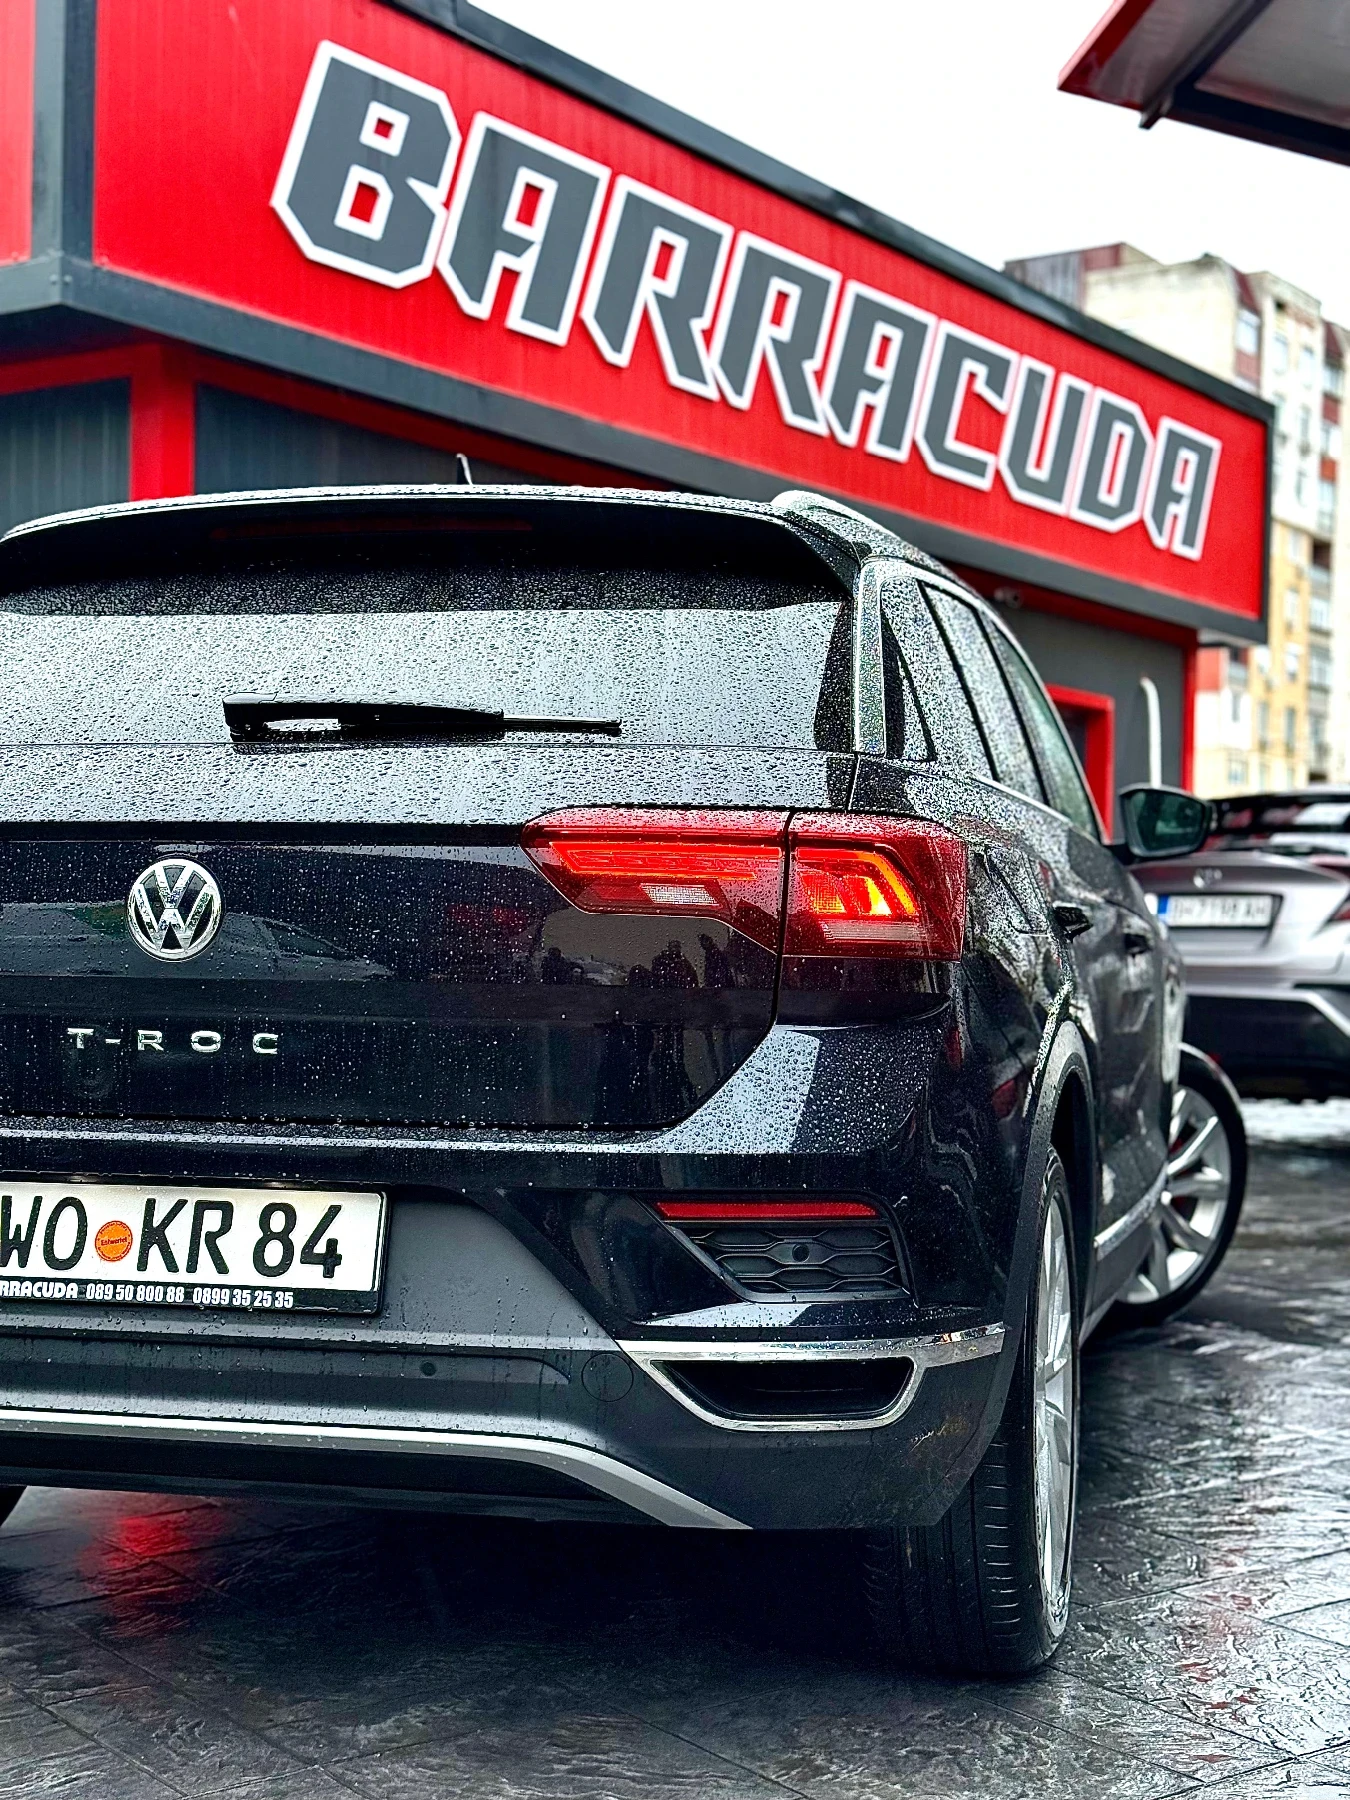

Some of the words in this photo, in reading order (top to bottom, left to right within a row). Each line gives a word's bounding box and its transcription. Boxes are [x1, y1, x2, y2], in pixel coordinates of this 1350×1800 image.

[271, 40, 1221, 561] BARRACUDA
[67, 1027, 279, 1055] T-ROC
[0, 1195, 88, 1271] WO
[136, 1197, 234, 1275] KR
[252, 1202, 343, 1279] 84
[85, 1283, 114, 1300] 089
[115, 1284, 135, 1301] 50
[136, 1284, 164, 1302] 800
[166, 1285, 185, 1303] 88
[192, 1287, 231, 1305] 0899
[232, 1288, 251, 1306] 35
[253, 1290, 273, 1308] 25
[274, 1291, 294, 1309] 35
